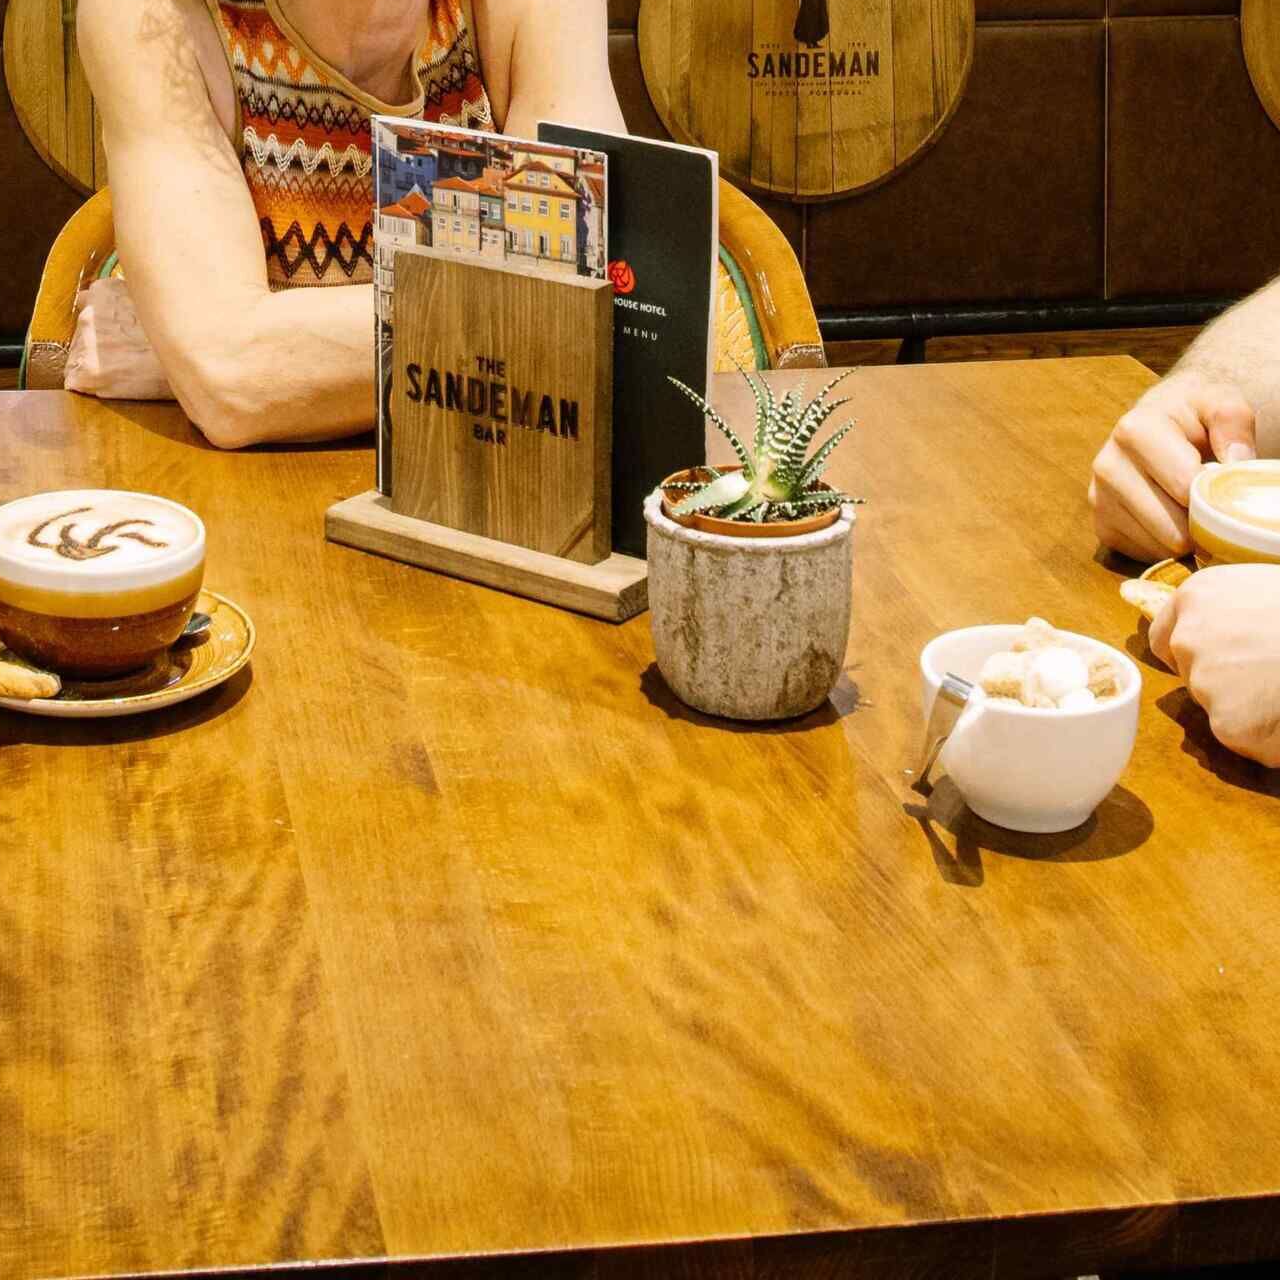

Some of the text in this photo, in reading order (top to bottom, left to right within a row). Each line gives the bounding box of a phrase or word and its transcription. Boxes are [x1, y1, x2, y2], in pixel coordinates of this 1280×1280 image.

[747, 51, 880, 79] SANDEMAN
[640, 302, 667, 317] HOTEL
[623, 325, 658, 341] MENU
[475, 355, 507, 378] THE
[406, 362, 580, 442] SANDEMAN
[473, 423, 507, 447] BAR
